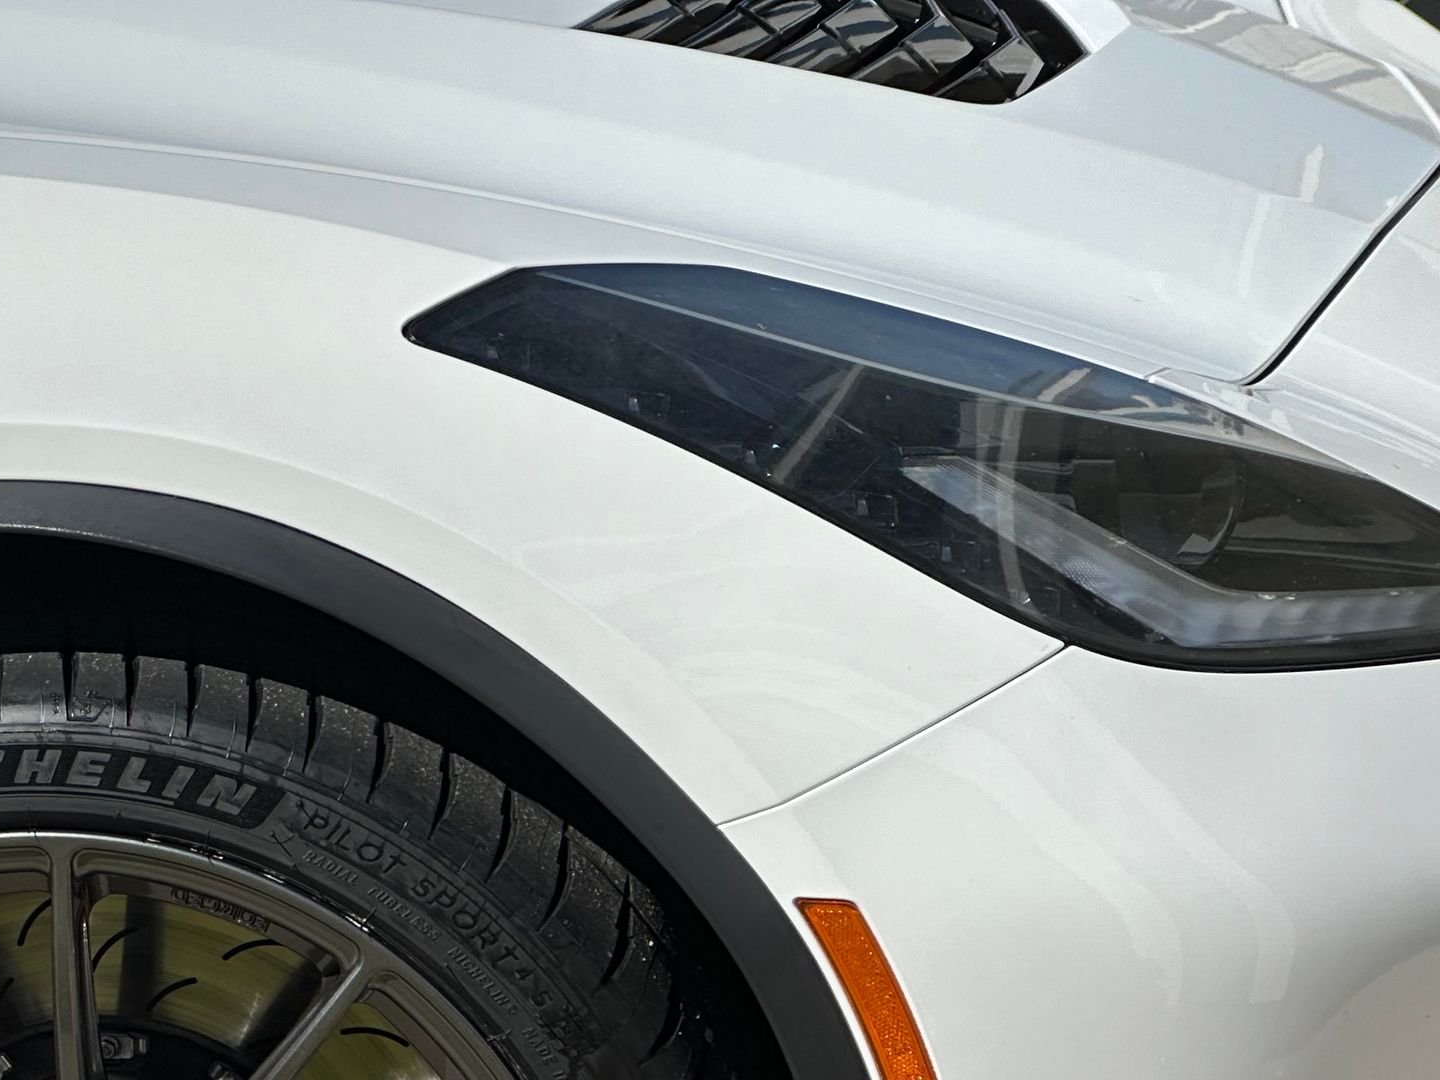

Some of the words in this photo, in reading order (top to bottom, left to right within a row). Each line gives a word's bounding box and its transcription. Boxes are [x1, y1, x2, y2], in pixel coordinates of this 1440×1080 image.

[300, 849, 361, 886] RADIAL
[303, 804, 408, 875] PILOT
[410, 876, 522, 972] SPORT
